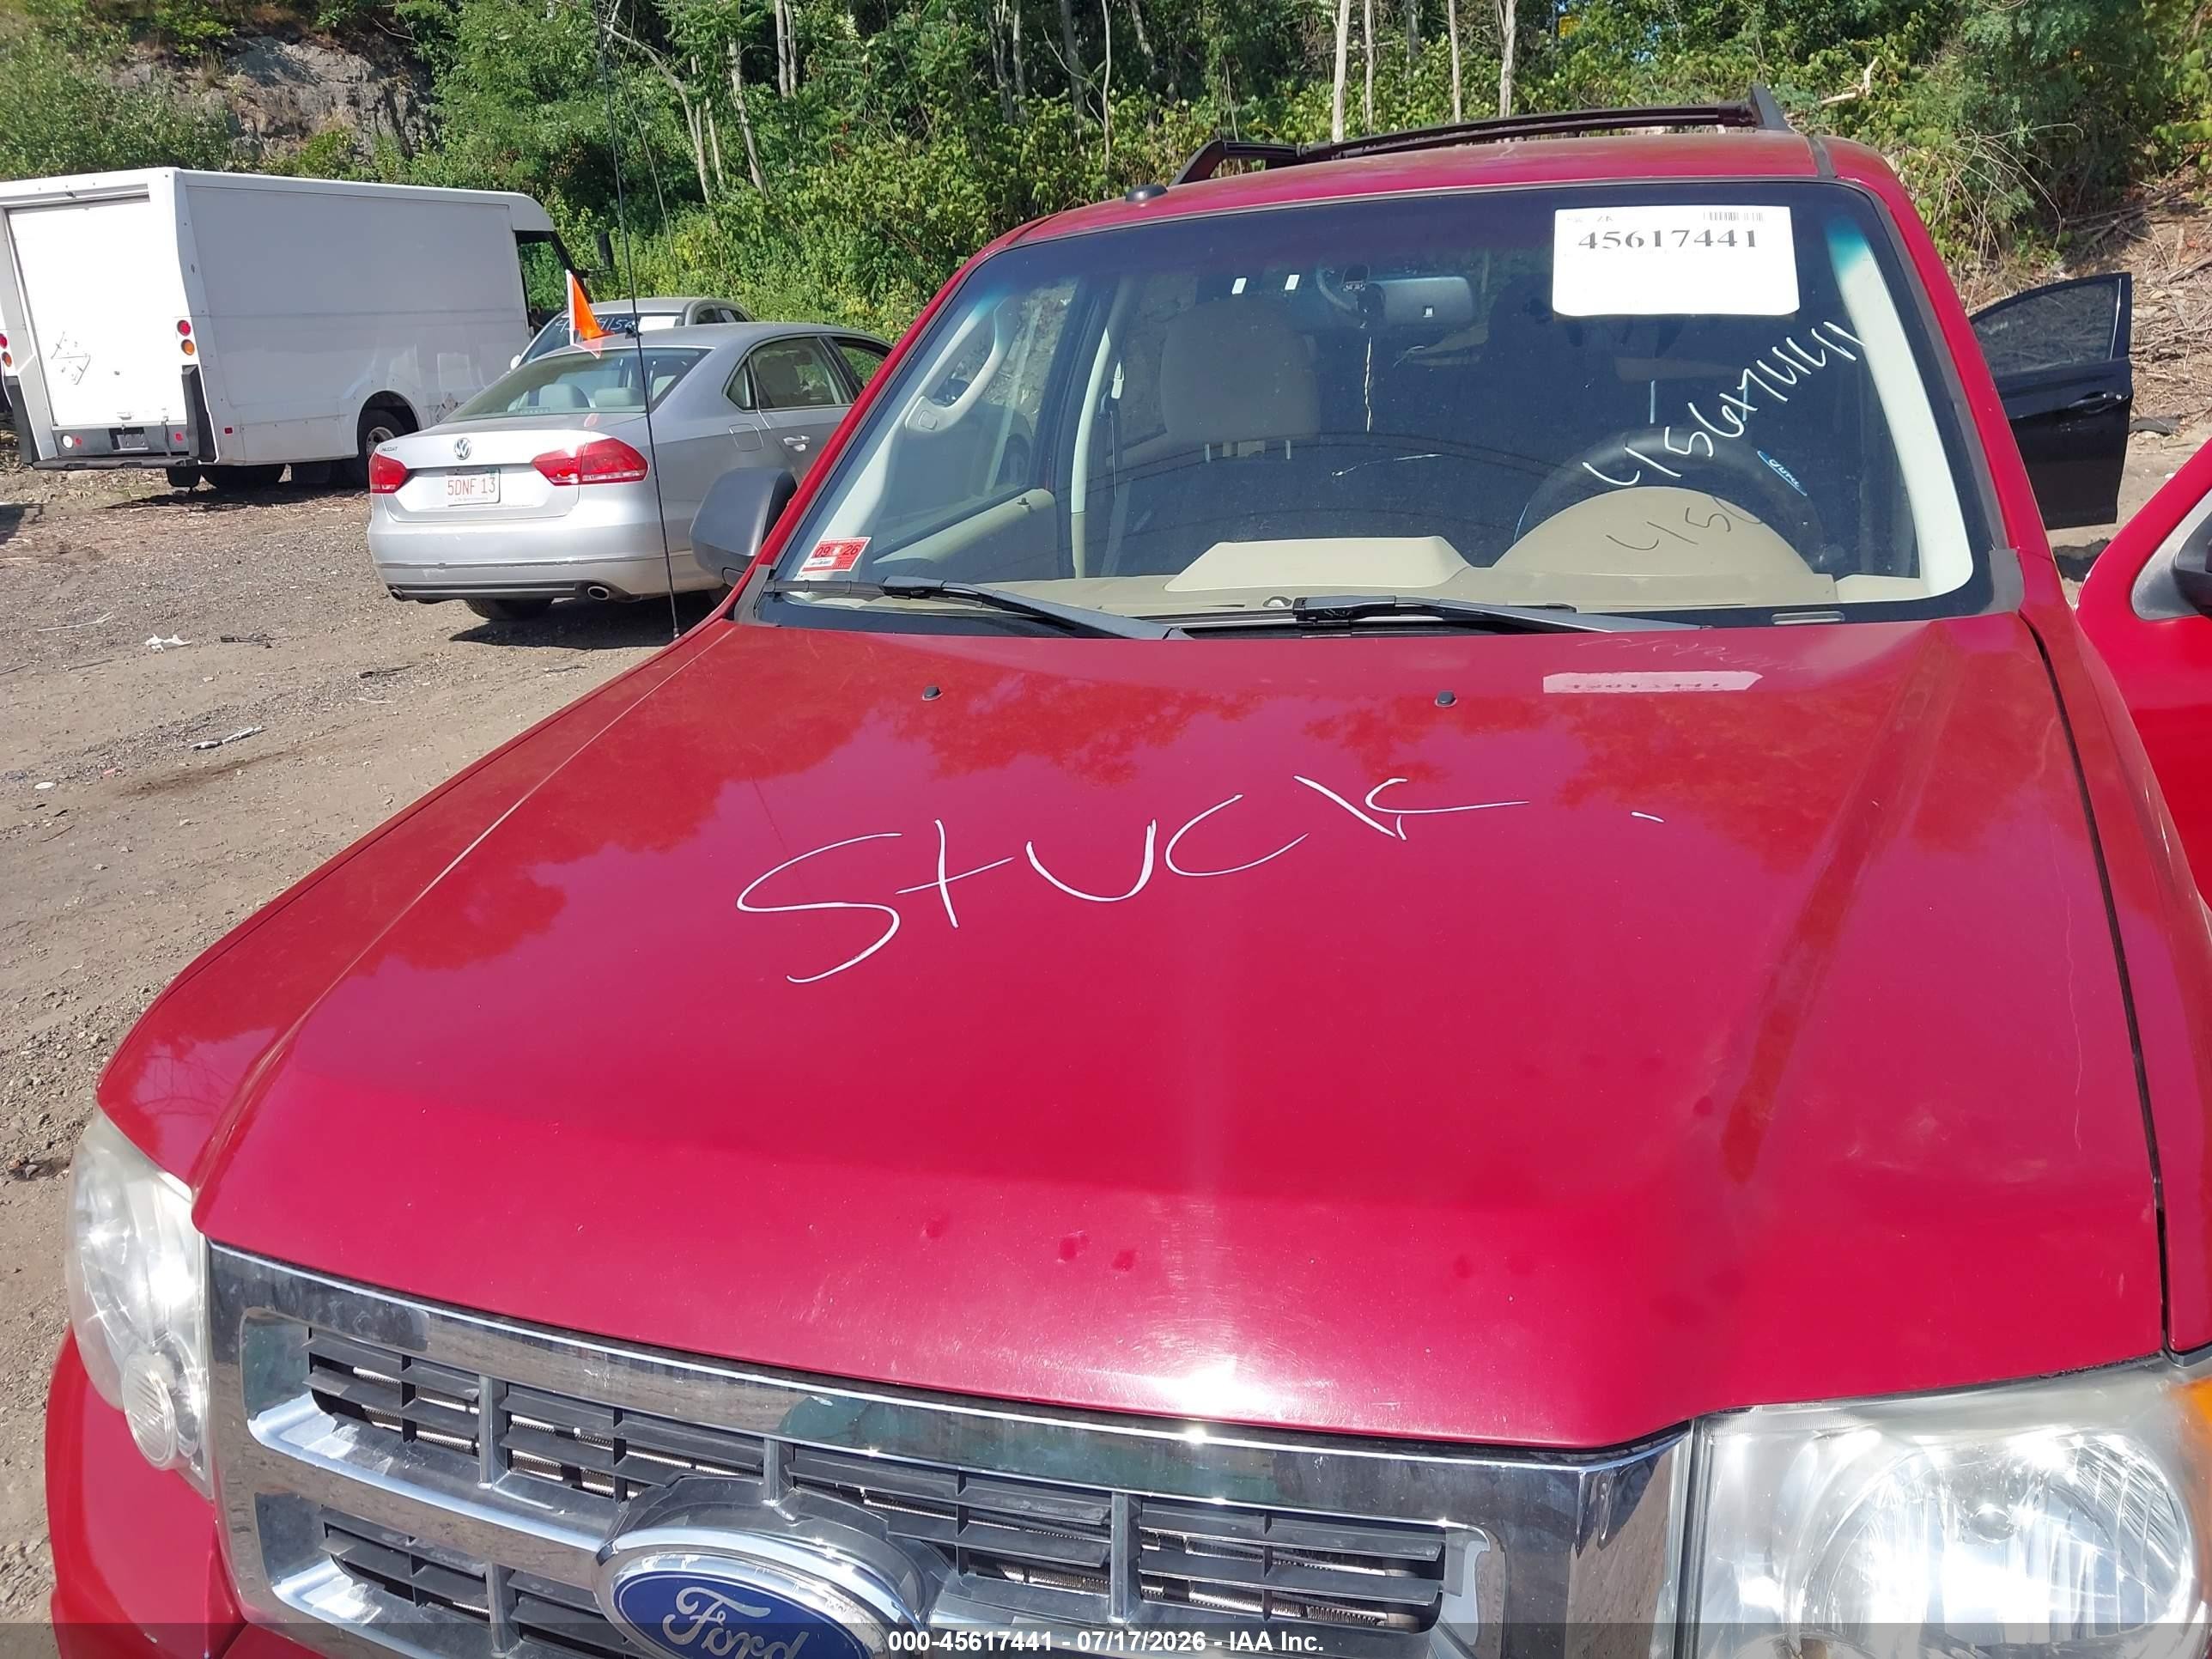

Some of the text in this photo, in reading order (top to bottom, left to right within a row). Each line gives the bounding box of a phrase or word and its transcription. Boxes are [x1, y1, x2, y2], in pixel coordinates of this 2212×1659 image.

[1577, 228, 1757, 250] 45617441
[447, 477, 495, 496] 5DNF 13
[815, 544, 861, 557] 09 26
[662, 1586, 810, 1658] Ford
